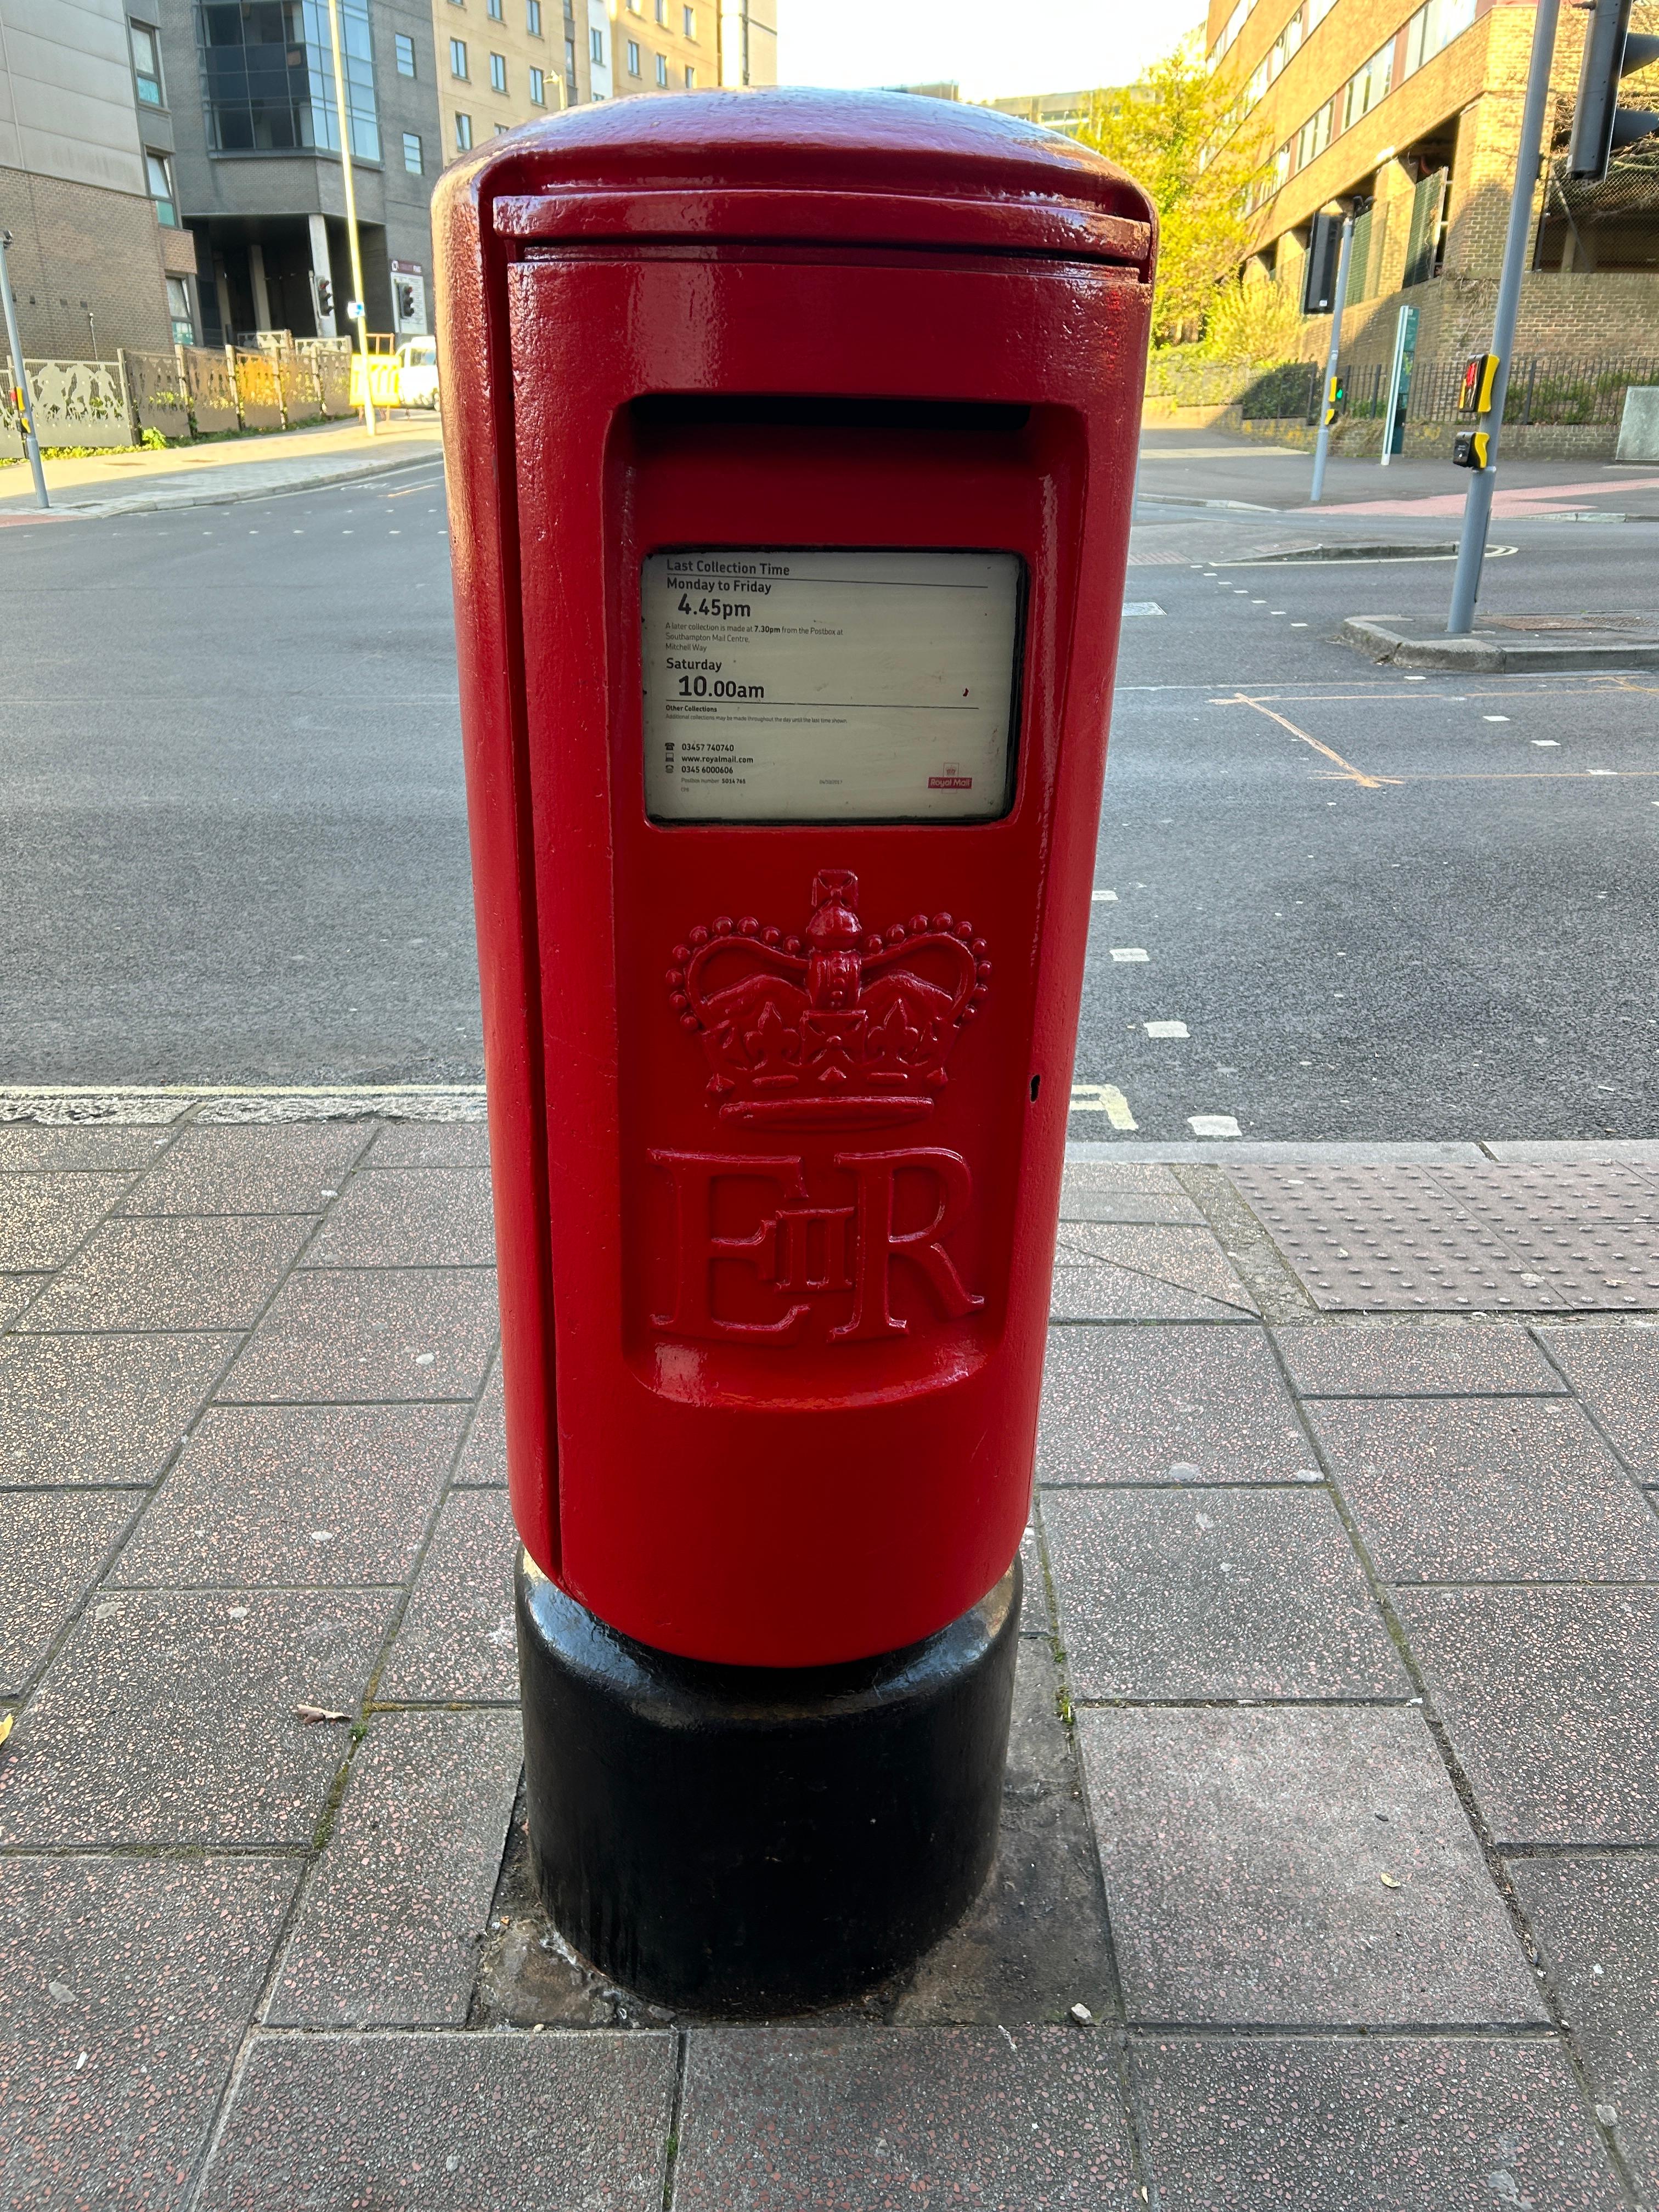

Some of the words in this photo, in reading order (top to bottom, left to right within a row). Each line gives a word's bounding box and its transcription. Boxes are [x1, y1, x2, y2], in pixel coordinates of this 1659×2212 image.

[667, 559, 693, 571] Last
[696, 560, 756, 574] Collection
[760, 563, 790, 575] Time
[667, 577, 715, 592] Monday
[718, 580, 730, 591] to
[733, 580, 772, 595] Friday
[678, 593, 751, 619] 4.45pm
[688, 623, 719, 631] collection
[754, 625, 781, 634] 7.30pm
[782, 626, 797, 634] from
[810, 627, 836, 636] Postbox
[837, 628, 844, 636] at
[665, 633, 710, 641] Southampton
[727, 635, 751, 643] Centre,
[692, 645, 707, 653] Way
[666, 657, 722, 673] Saturday
[679, 675, 764, 698] 10.00am
[681, 755, 754, 764] www.royalmail.com
[930, 778, 952, 787] Royal
